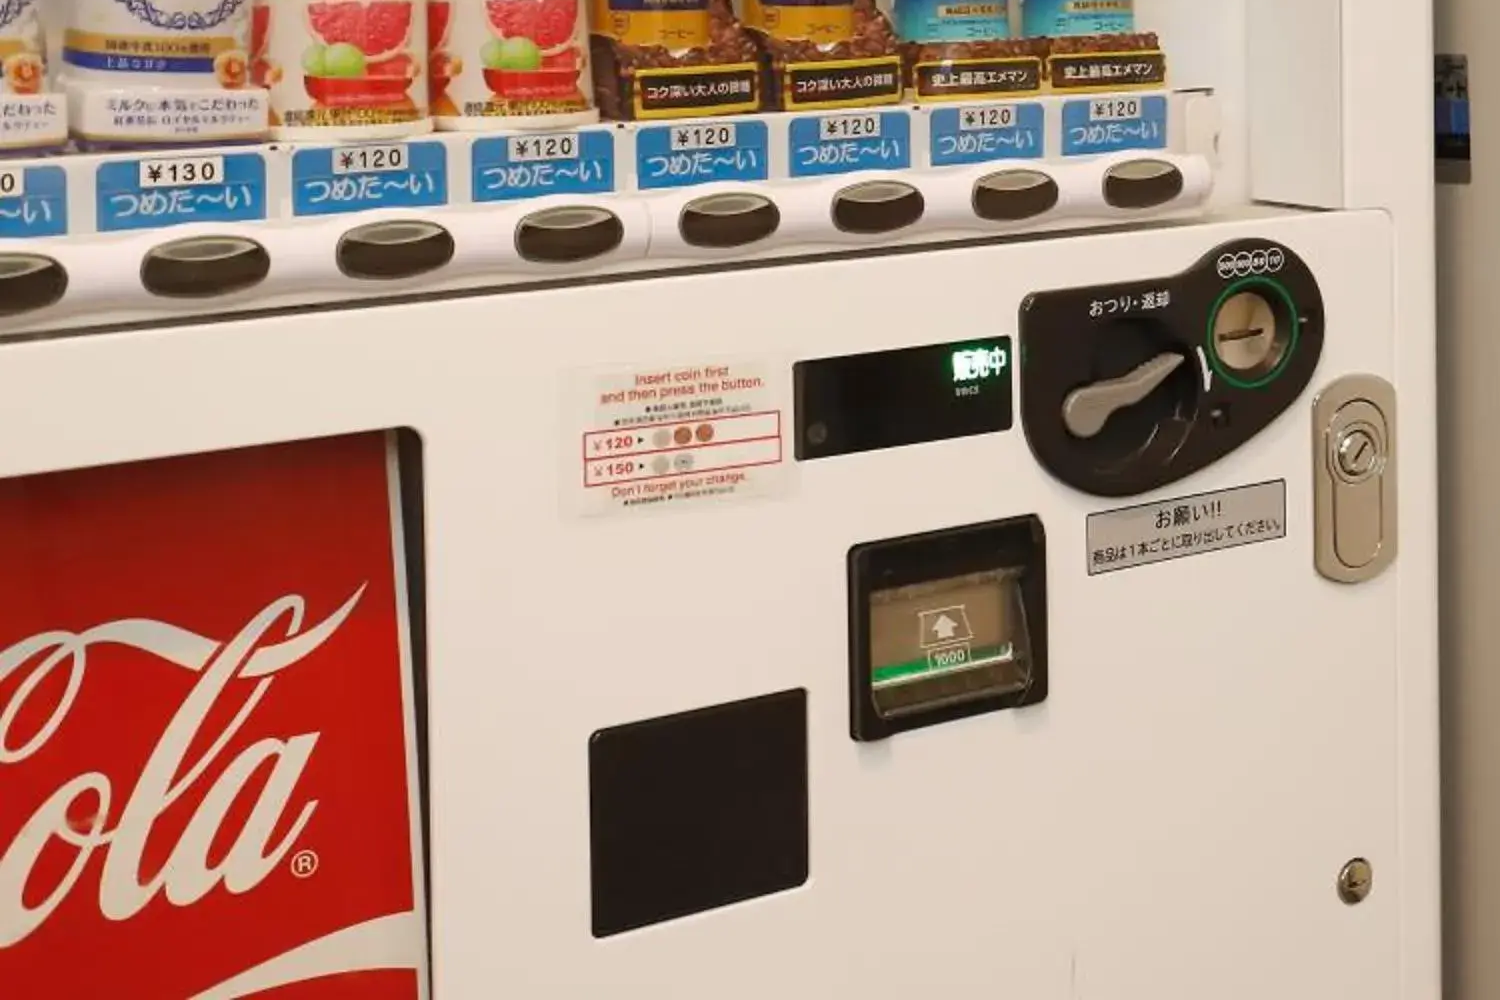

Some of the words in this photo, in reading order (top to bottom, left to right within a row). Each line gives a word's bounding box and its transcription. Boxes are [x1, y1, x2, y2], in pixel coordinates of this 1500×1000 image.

[965, 108, 1011, 126] ¥120
[1095, 100, 1137, 118] ¥120
[678, 127, 731, 146] ¥120
[827, 118, 876, 136] ¥120
[515, 138, 572, 157] ¥120
[339, 148, 402, 169] ¥120
[148, 161, 216, 183] ¥130
[1089, 289, 1170, 317] おつり・返却
[635, 372, 672, 386] Insert
[675, 369, 701, 382] coin
[705, 366, 729, 378] first
[600, 389, 625, 405] and
[628, 387, 657, 401] then
[660, 384, 695, 399] press
[699, 381, 719, 393] the
[643, 481, 677, 496] forget
[679, 478, 702, 491] your
[934, 649, 965, 667] 1000
